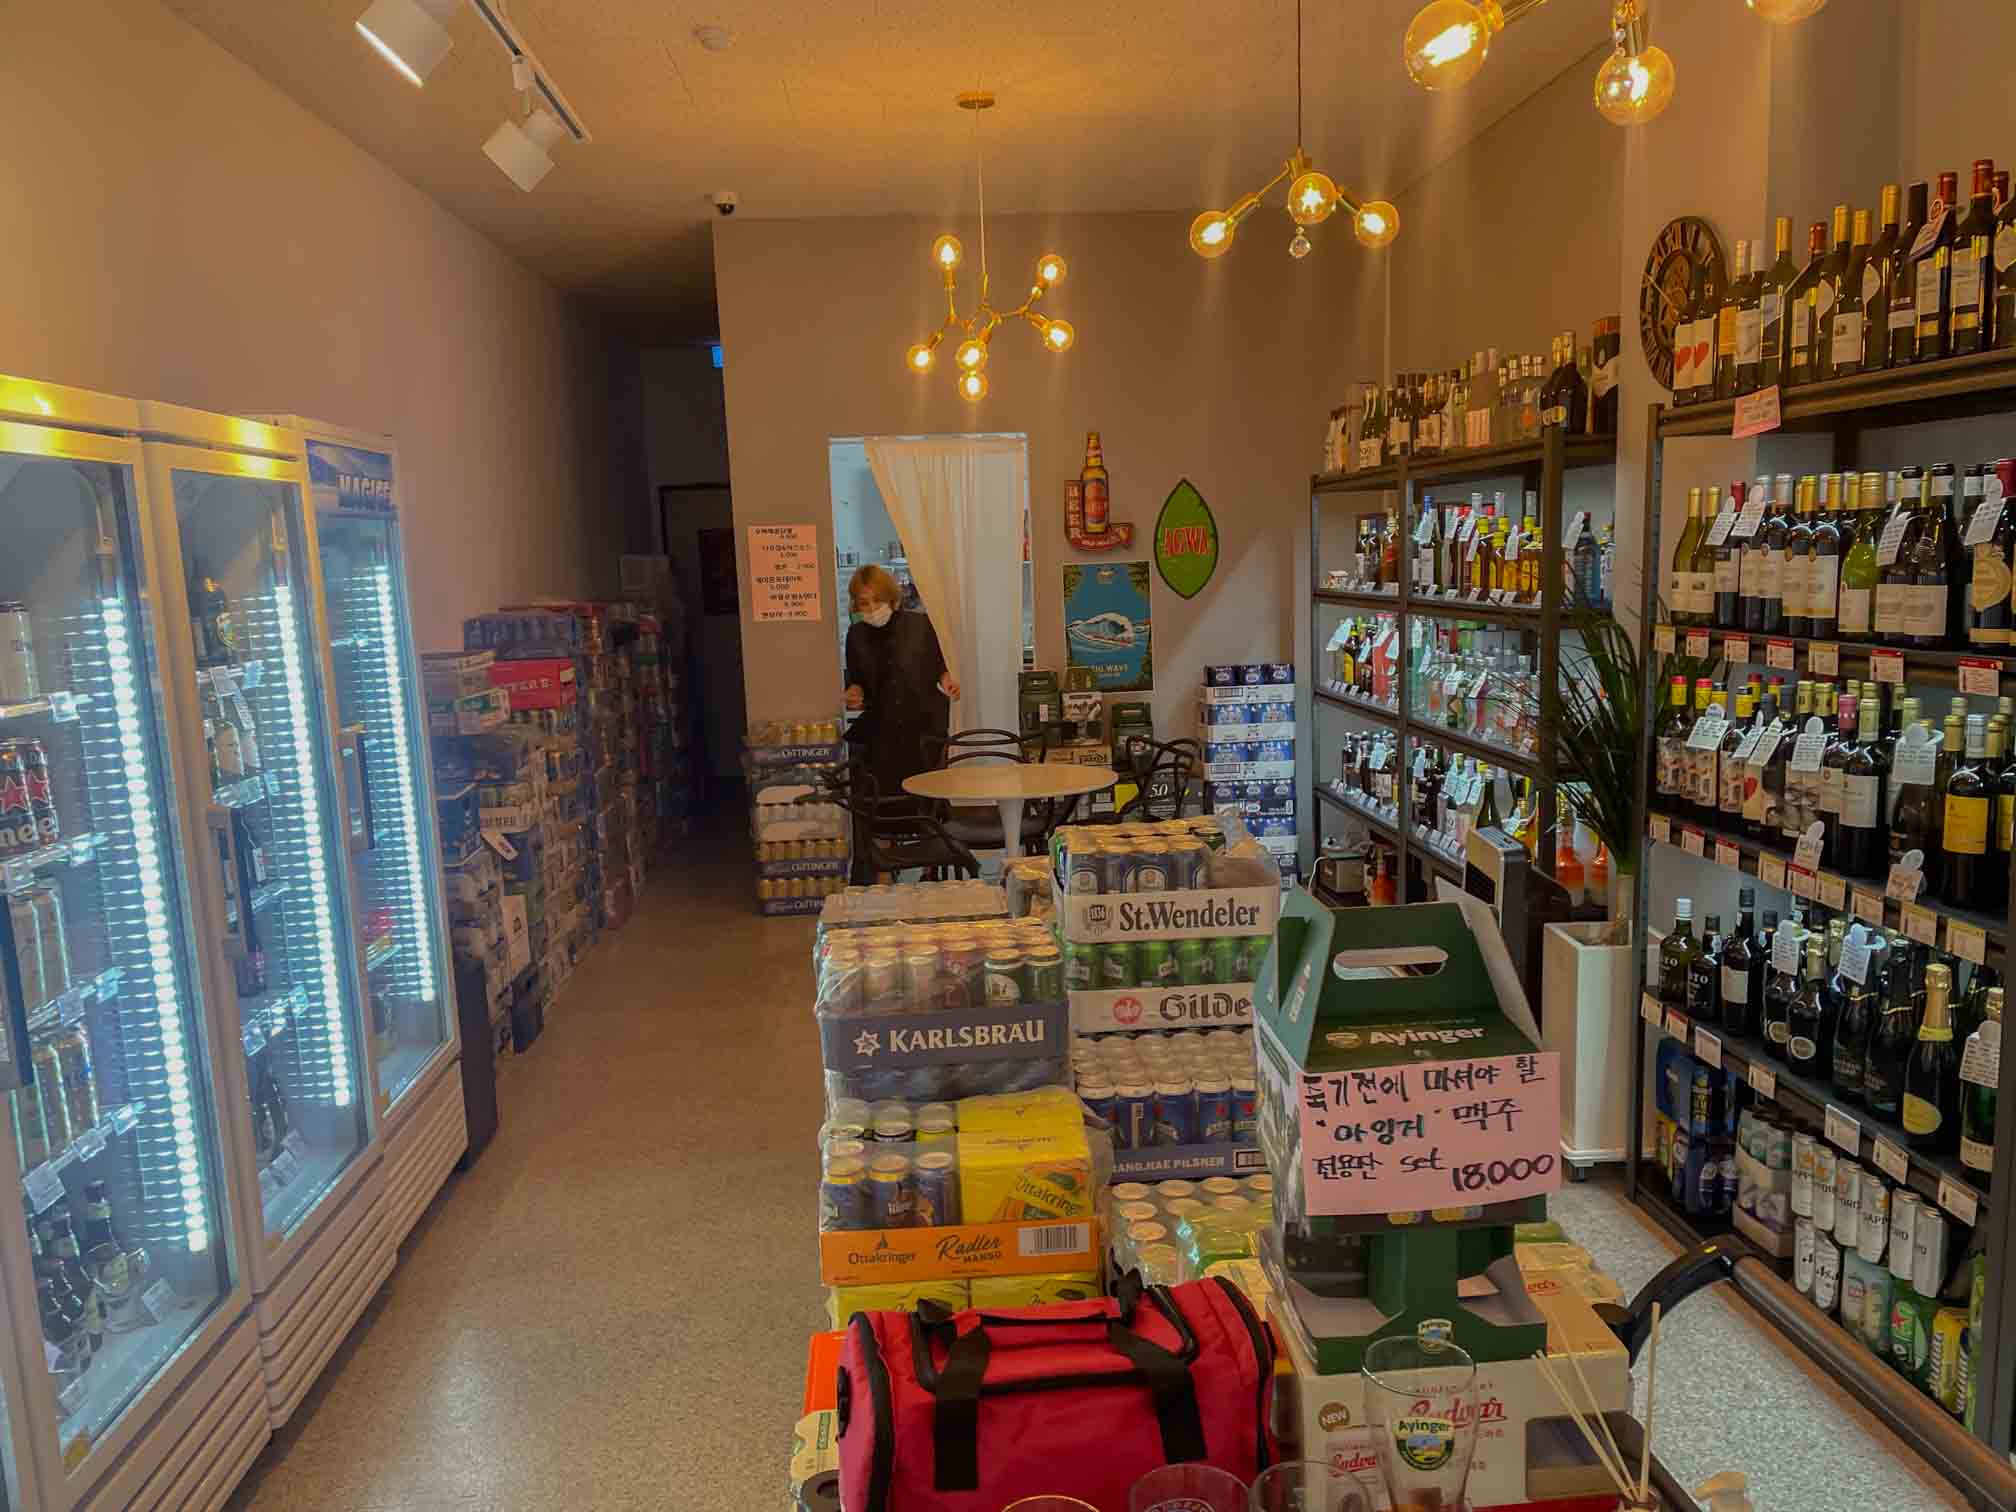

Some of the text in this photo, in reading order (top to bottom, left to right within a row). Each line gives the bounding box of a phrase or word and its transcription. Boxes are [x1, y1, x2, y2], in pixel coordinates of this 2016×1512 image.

[1164, 527, 1208, 557] AGWA
[1119, 897, 1260, 932] St.Wendeler
[1369, 1026, 1484, 1046] Ayinger
[1452, 1098, 1523, 1132] 맥주
[848, 1251, 917, 1265] Ottakringer
[1321, 1410, 1347, 1424] NEW
[1398, 1419, 1451, 1434] Ayinger
